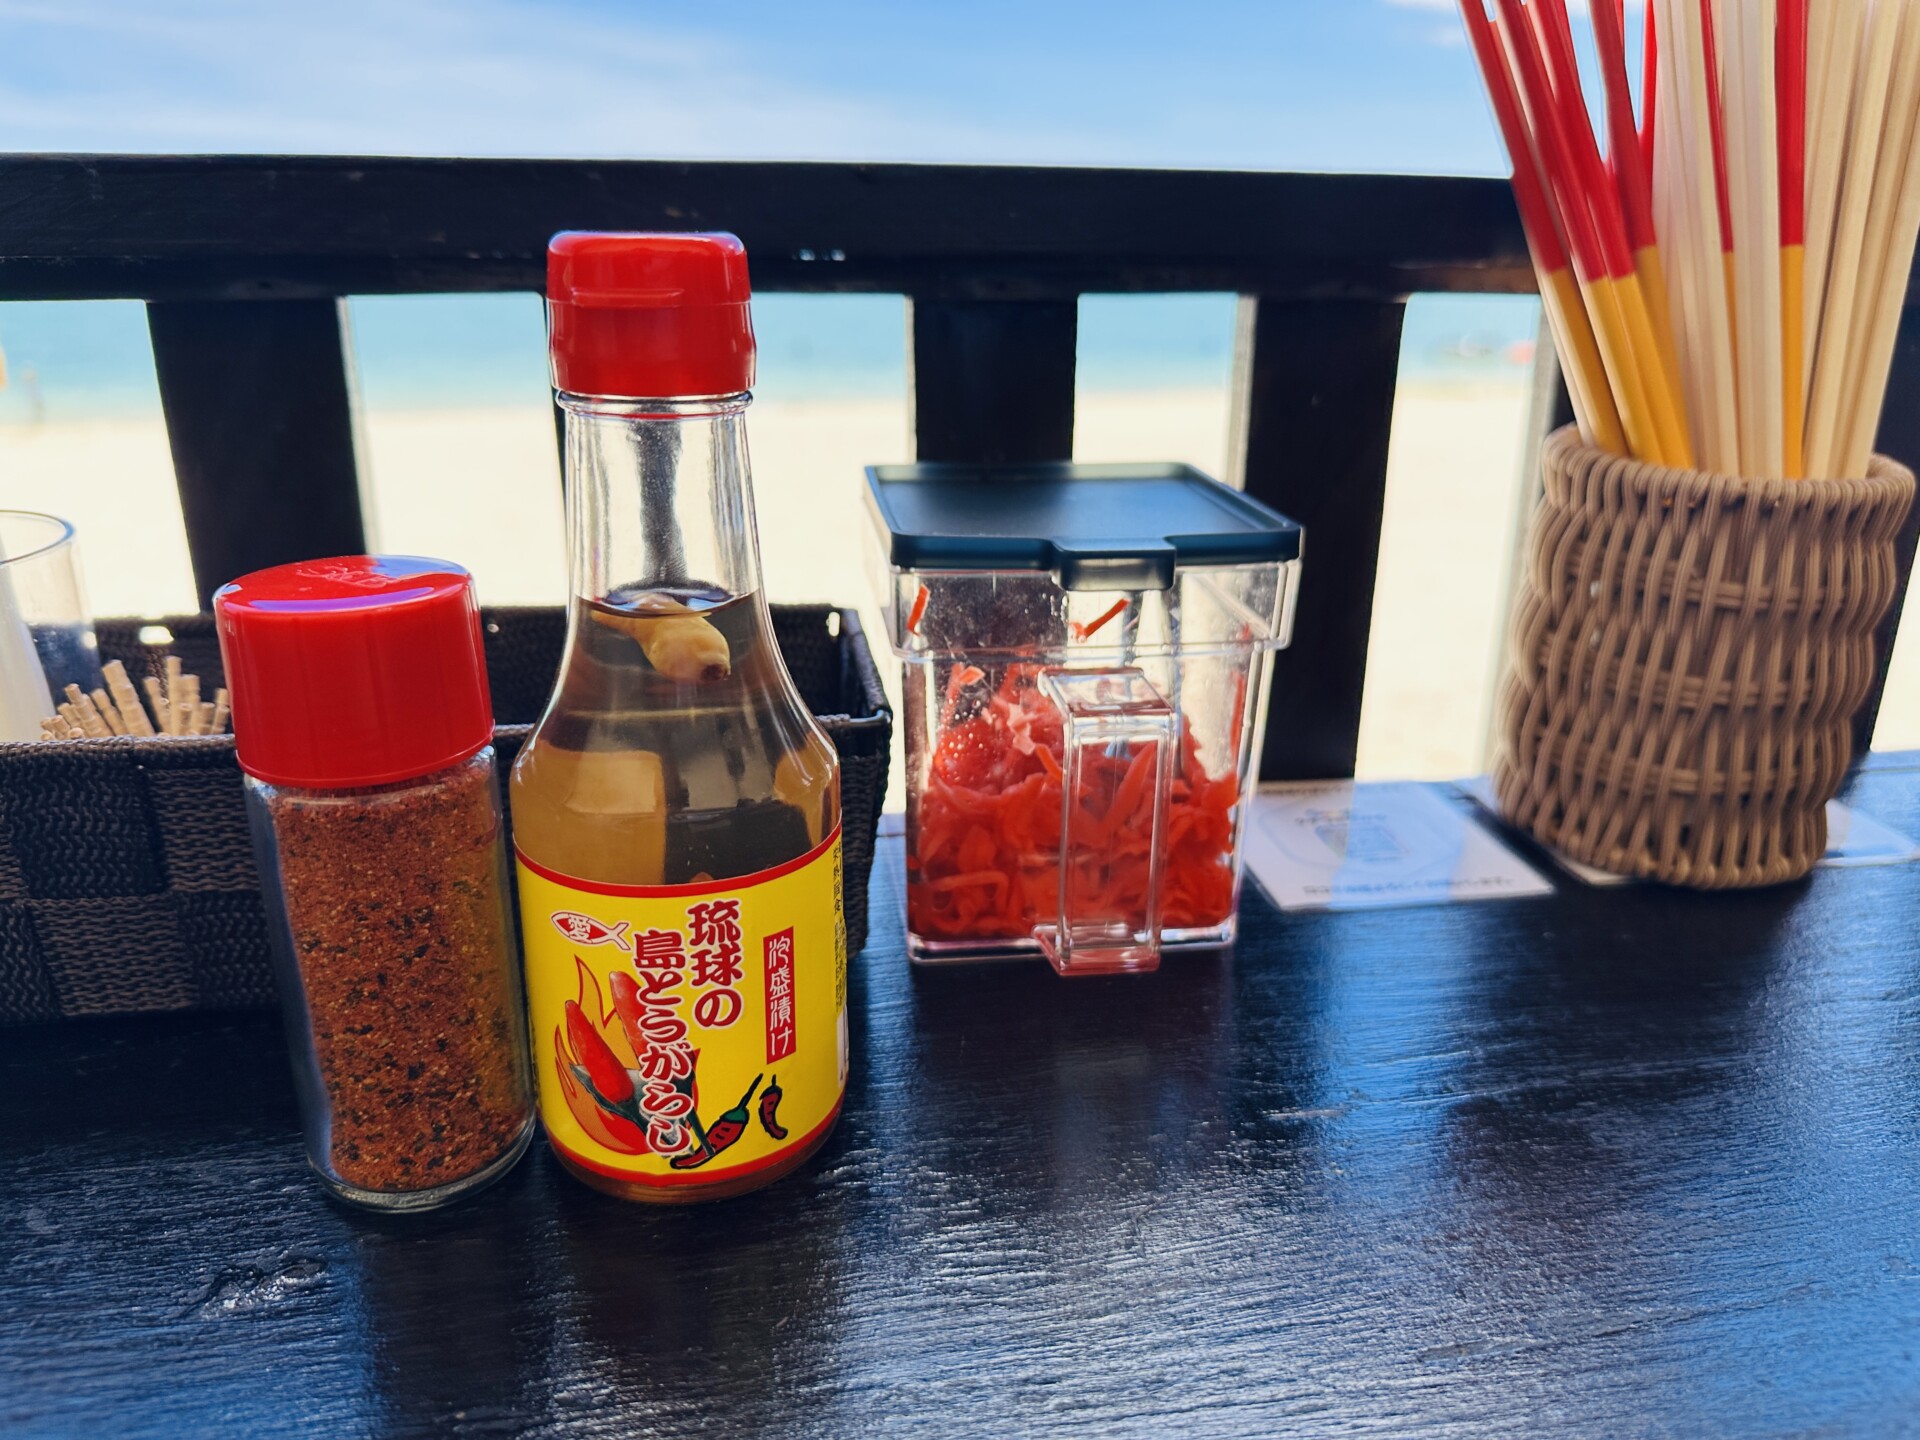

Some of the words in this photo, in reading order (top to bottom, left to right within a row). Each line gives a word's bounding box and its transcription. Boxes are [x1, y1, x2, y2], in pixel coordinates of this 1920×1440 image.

[688, 900, 743, 1027] 琉球の
[768, 935, 793, 1056] 泡盛漬け
[634, 930, 692, 1155] 島とうがらし
